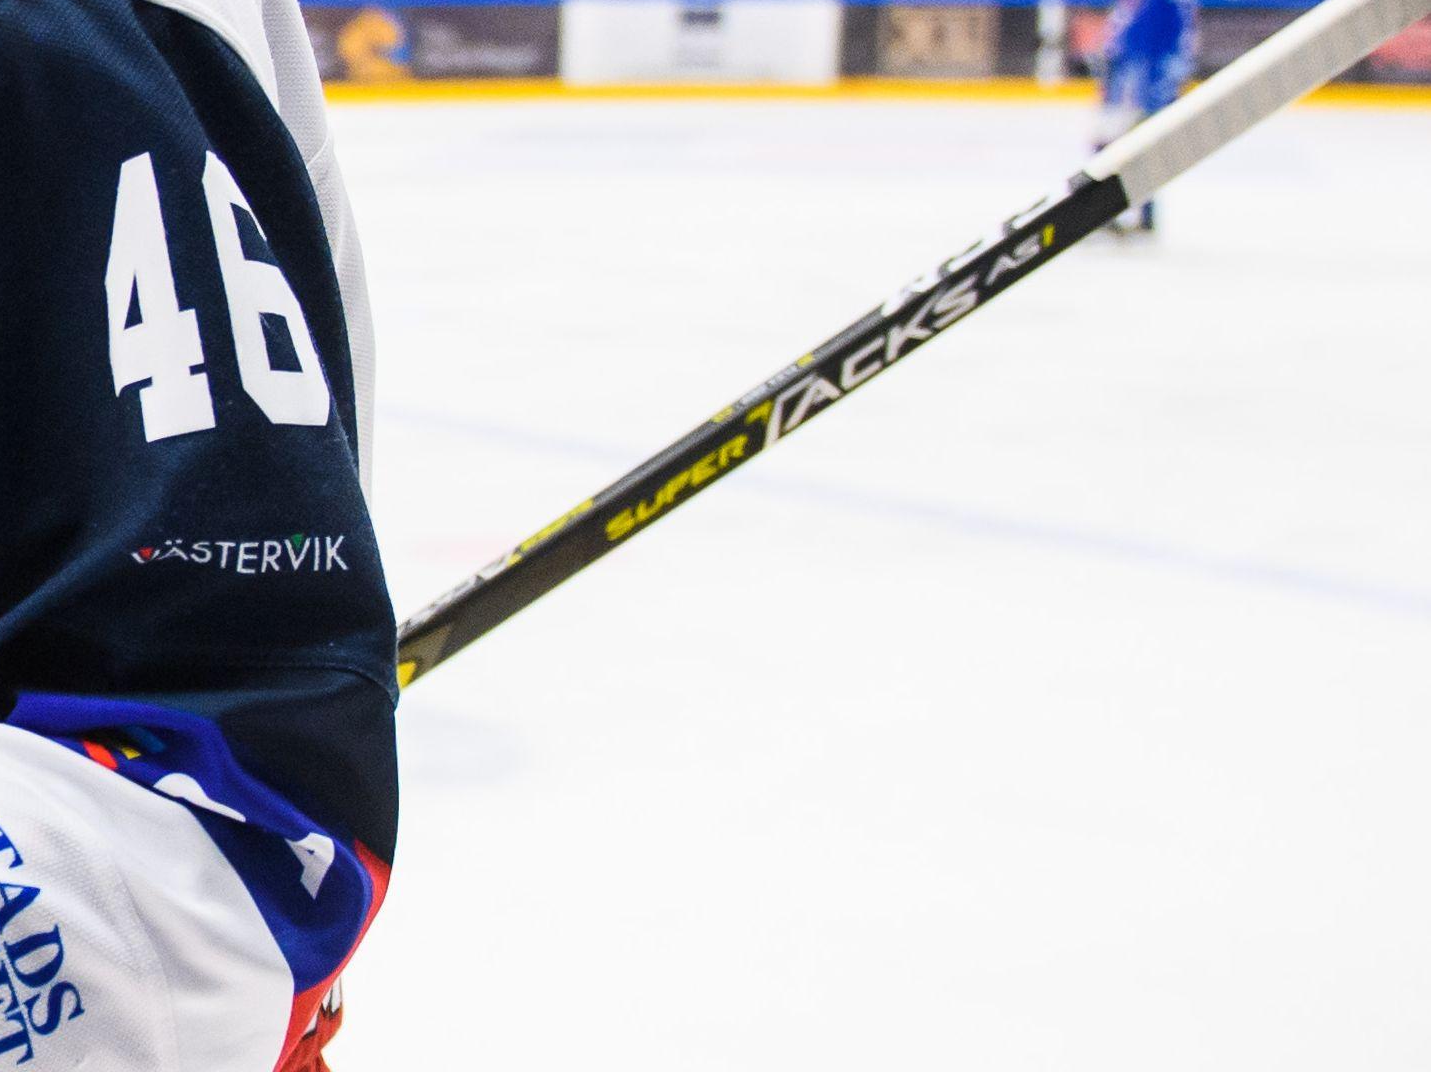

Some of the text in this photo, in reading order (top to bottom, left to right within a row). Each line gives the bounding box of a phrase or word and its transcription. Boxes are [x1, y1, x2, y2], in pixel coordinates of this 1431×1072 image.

[104, 150, 331, 444] 46
[605, 434, 749, 542] SUPER
[763, 272, 980, 444] TACKS
[131, 534, 349, 575] VÄSTERVIK
